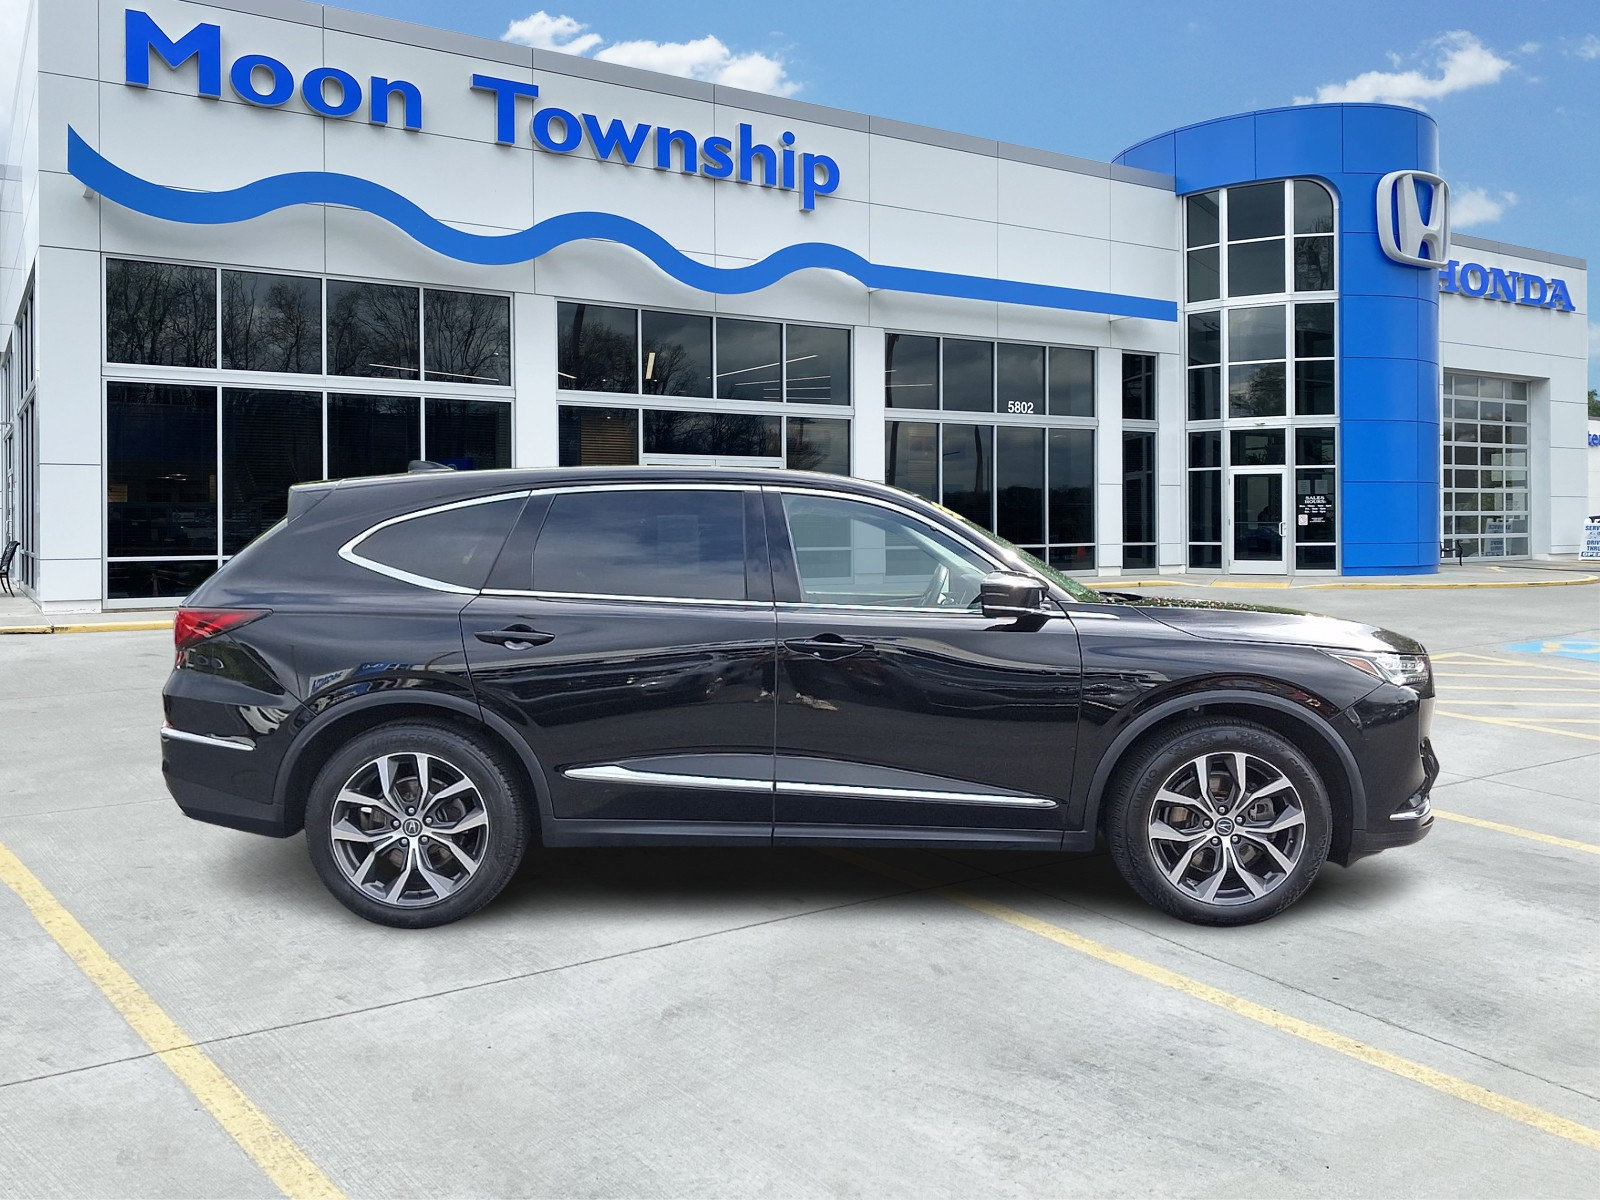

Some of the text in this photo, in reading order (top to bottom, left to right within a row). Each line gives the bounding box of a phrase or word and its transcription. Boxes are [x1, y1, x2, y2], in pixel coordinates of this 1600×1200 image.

[125, 9, 840, 211] Moon Township
[1007, 401, 1034, 414] 5802
[1588, 431, 1600, 447] te
